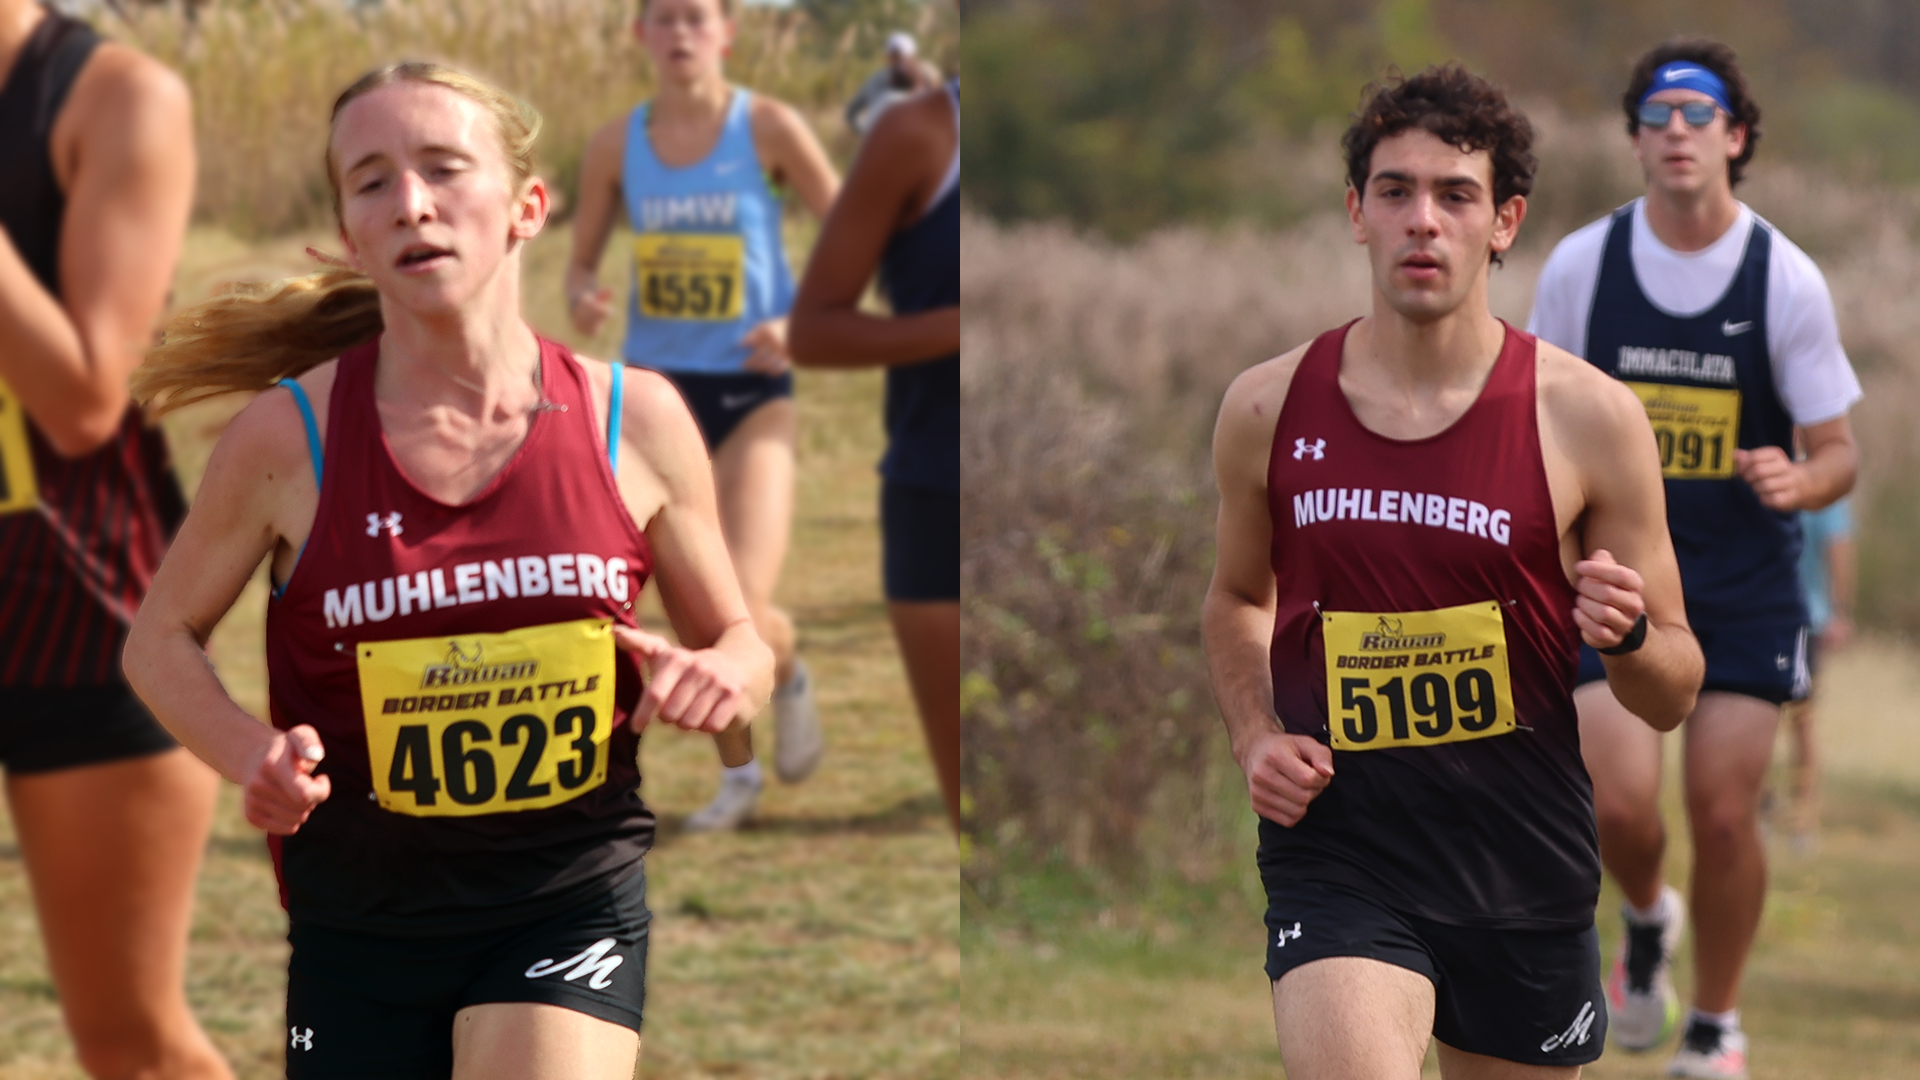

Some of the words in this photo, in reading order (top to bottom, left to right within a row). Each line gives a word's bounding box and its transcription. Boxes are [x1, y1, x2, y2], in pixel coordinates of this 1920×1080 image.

[641, 192, 737, 230] UMW
[645, 272, 734, 316] 4557
[1656, 427, 1724, 471] 091
[1293, 488, 1511, 546] MUHLENBERG
[323, 554, 629, 629] MUHLENBERG
[1336, 654, 1410, 669] BORDER
[1414, 645, 1495, 667] BATTLE
[1360, 632, 1446, 651] Rowan
[381, 691, 490, 715] BORDER
[497, 675, 601, 707] BATTLE
[423, 660, 540, 688] Rowan
[1340, 668, 1498, 743] 5199
[388, 706, 597, 806] 4623
[524, 936, 625, 991] M
